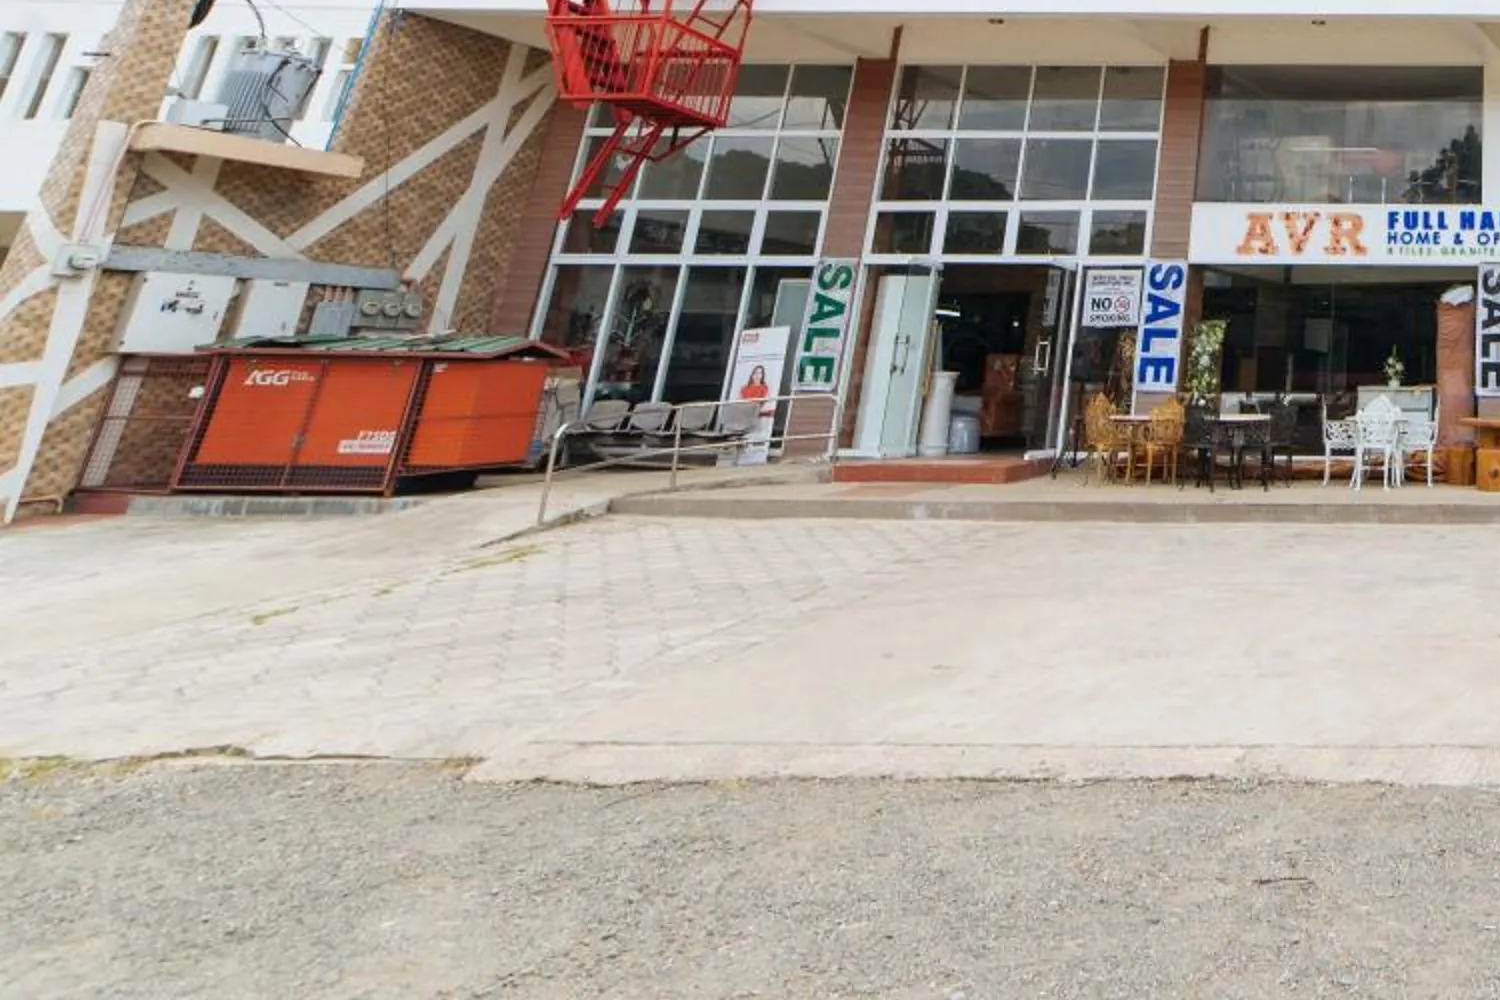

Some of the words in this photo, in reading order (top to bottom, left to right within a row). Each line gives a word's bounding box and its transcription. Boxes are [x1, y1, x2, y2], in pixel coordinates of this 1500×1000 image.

[1236, 212, 1368, 255] AVR
[1388, 211, 1448, 230] FULL
[1387, 231, 1440, 245] HOME
[1453, 232, 1464, 245] &
[1091, 297, 1112, 312] NO
[798, 263, 854, 383] SALE
[1138, 263, 1185, 384] SALE
